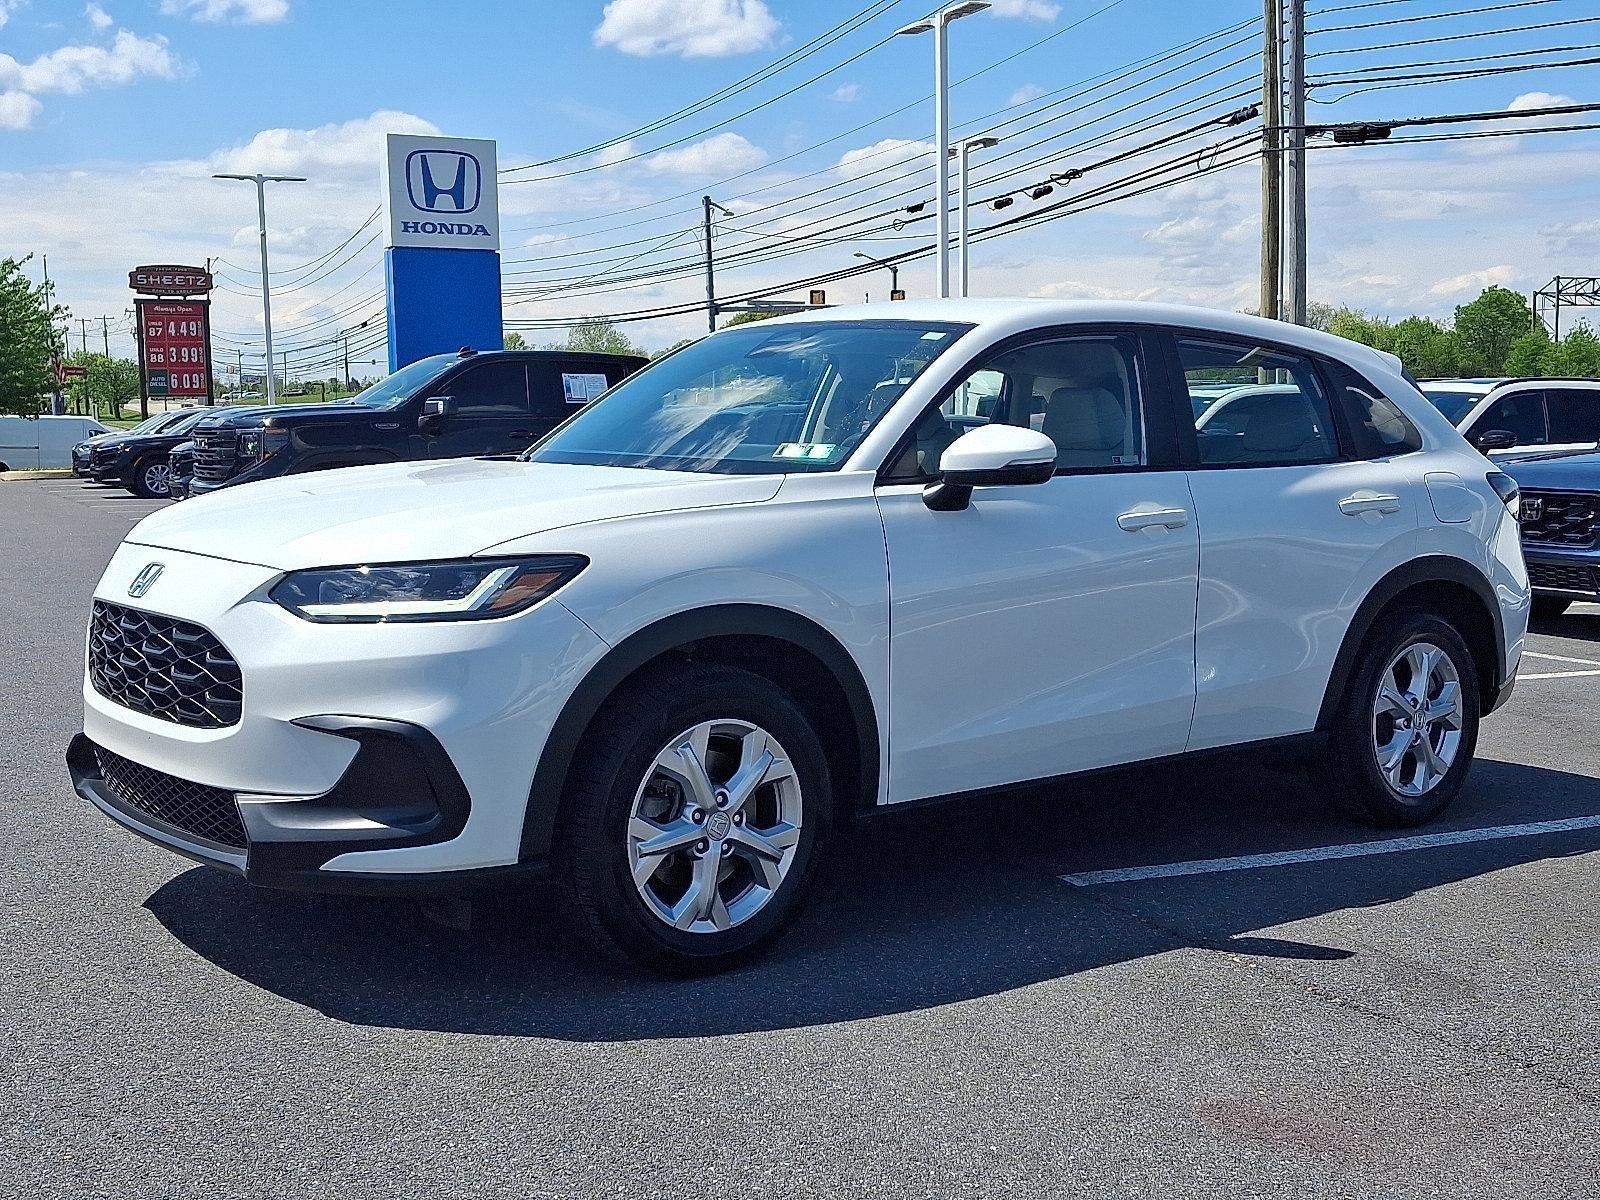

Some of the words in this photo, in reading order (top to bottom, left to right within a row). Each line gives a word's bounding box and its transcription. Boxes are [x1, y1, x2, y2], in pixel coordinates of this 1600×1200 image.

[401, 221, 491, 236] HONDA
[137, 274, 206, 286] SHEETZ
[153, 305, 176, 314] Always
[176, 305, 193, 314] Open
[149, 327, 163, 337] 87
[168, 321, 197, 337] 4.49
[150, 353, 165, 363] 88
[169, 347, 198, 363] 3.99
[170, 373, 200, 389] 6.09
